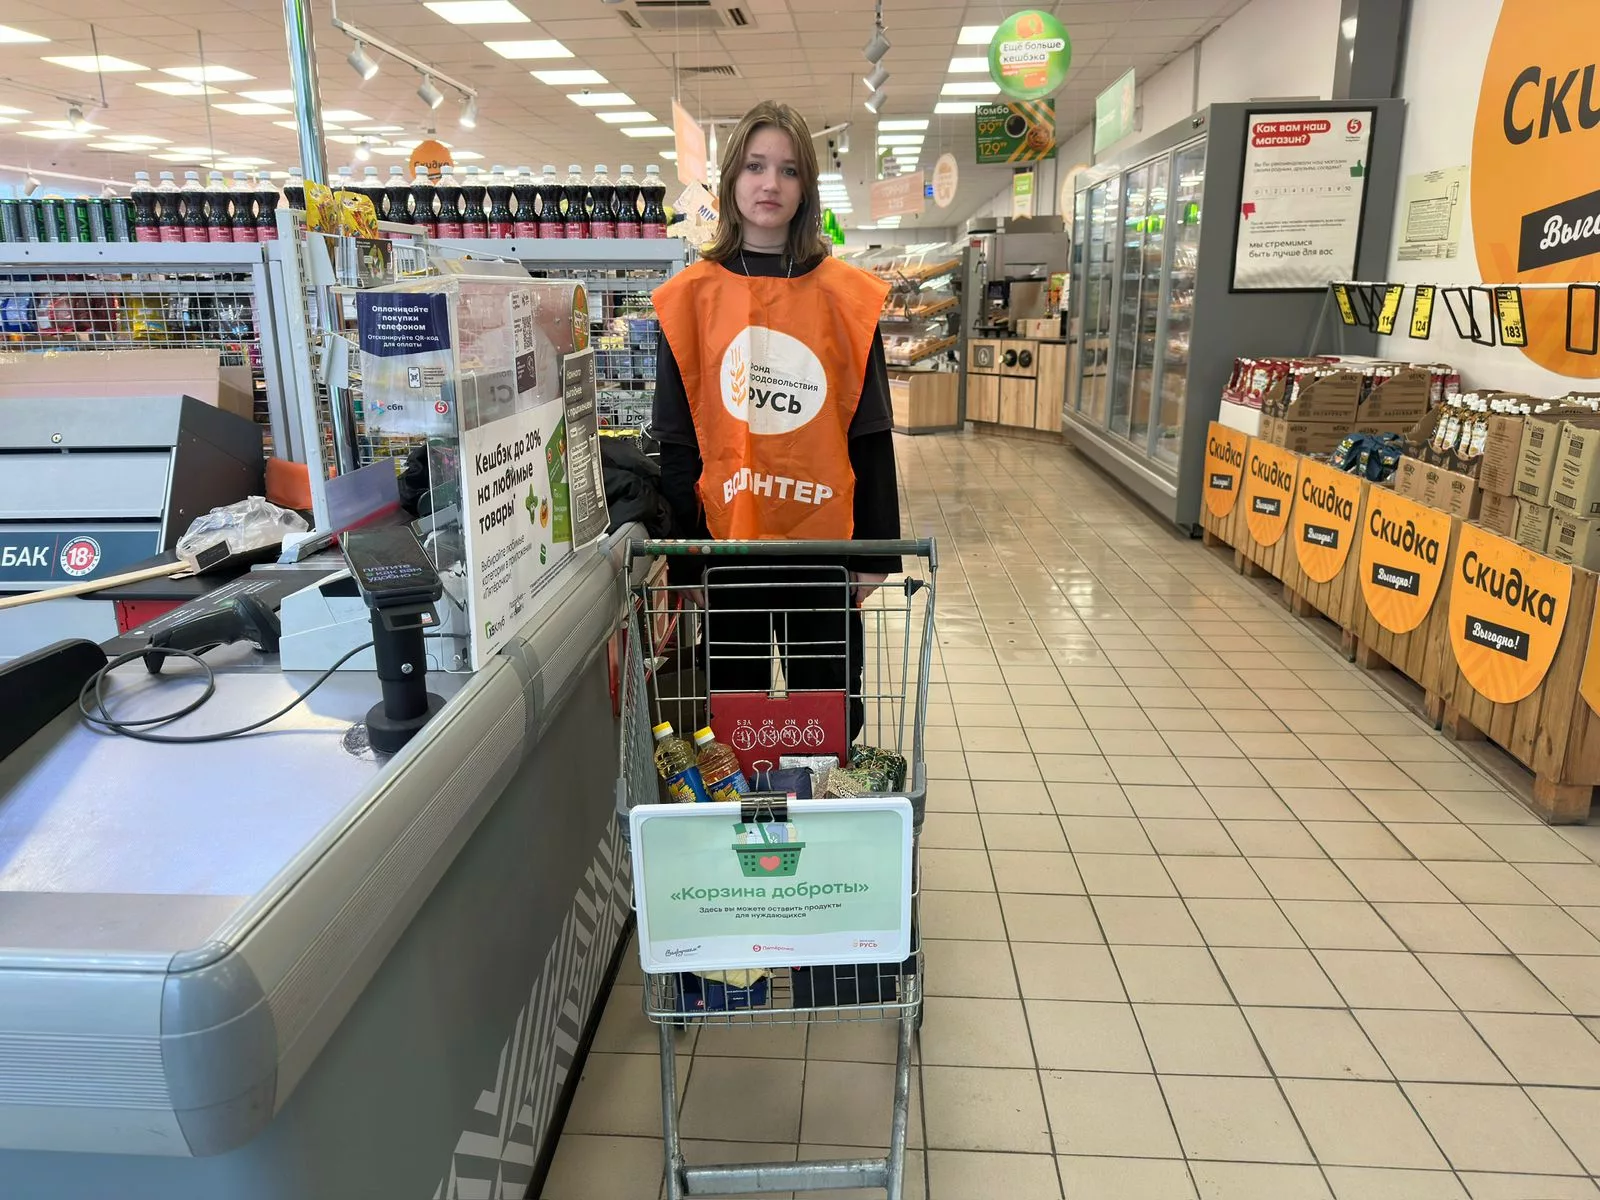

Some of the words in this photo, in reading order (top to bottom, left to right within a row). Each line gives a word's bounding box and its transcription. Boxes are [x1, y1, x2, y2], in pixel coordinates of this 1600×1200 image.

[1003, 54, 1046, 62] кешбэка
[977, 106, 1009, 115] Комбо
[1257, 124, 1276, 133] Как
[1280, 124, 1300, 132] вам
[1303, 123, 1327, 131] наш
[1255, 135, 1307, 145] магазин?
[1249, 250, 1271, 258] быть
[1272, 250, 1301, 258] лучше
[1303, 248, 1317, 256] для
[1265, 240, 1313, 249] стремимся
[372, 305, 429, 314] Оплачивайте
[377, 323, 426, 331] телефоном
[1505, 325, 1521, 338] 183
[475, 442, 512, 476] Кешбэк
[514, 440, 525, 461] до
[525, 428, 542, 453] 20%
[1209, 437, 1242, 468] Скидка
[1251, 455, 1291, 492] Скидка
[477, 484, 491, 507] на
[492, 462, 534, 499] любимые
[1302, 477, 1353, 522] Скидка
[1370, 508, 1440, 565] Скидка
[69, 547, 94, 566] 18+
[1377, 567, 1413, 589] Выгодно!
[1462, 550, 1556, 626] Скидка
[1472, 622, 1520, 650] Выгодно!
[671, 886, 766, 902] «Корзина
[772, 881, 870, 899] доброты»
[699, 906, 723, 914] Здесь
[804, 902, 842, 912] продукты
